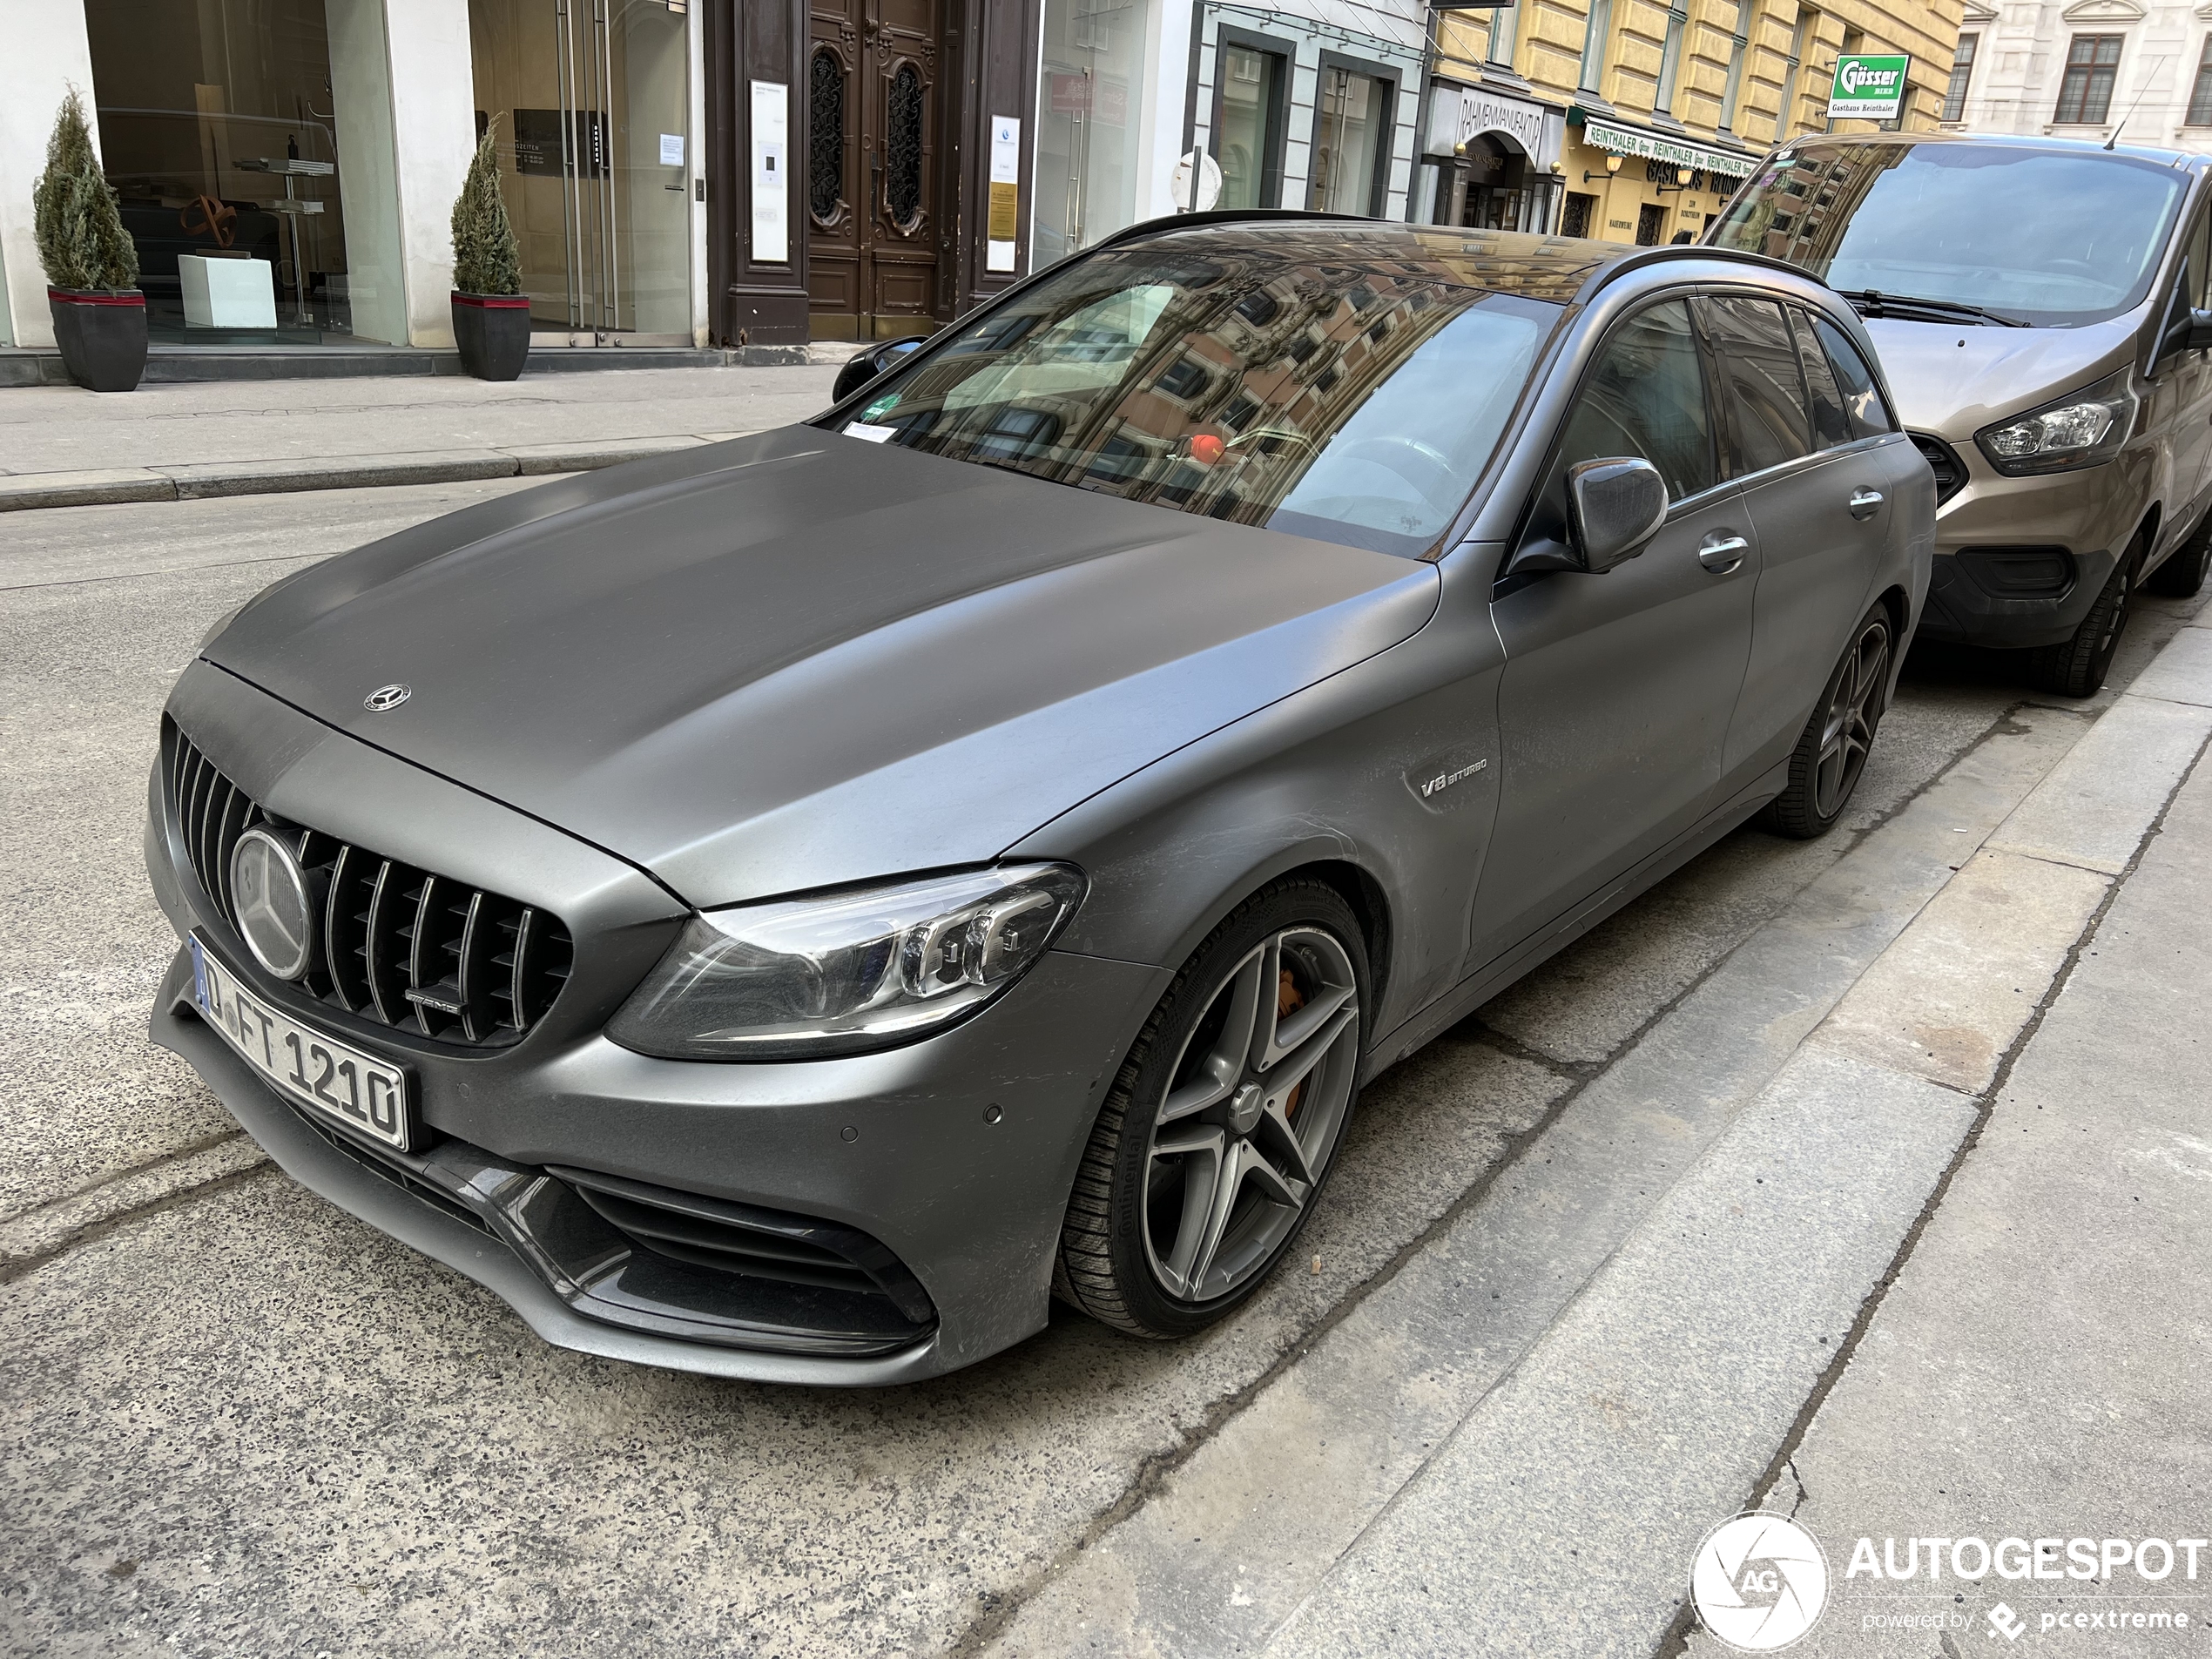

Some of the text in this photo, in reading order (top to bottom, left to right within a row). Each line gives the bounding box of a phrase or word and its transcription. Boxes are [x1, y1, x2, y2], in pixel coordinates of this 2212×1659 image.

[1840, 60, 1899, 95] Gösser
[1591, 127, 1636, 151] REINTHALER
[1654, 142, 1693, 163] REINTHALER
[1707, 155, 1742, 173] REINTHALER
[1421, 759, 1487, 798] V8 BITURBO
[236, 989, 274, 1069] FT
[285, 1029, 396, 1136] 1210
